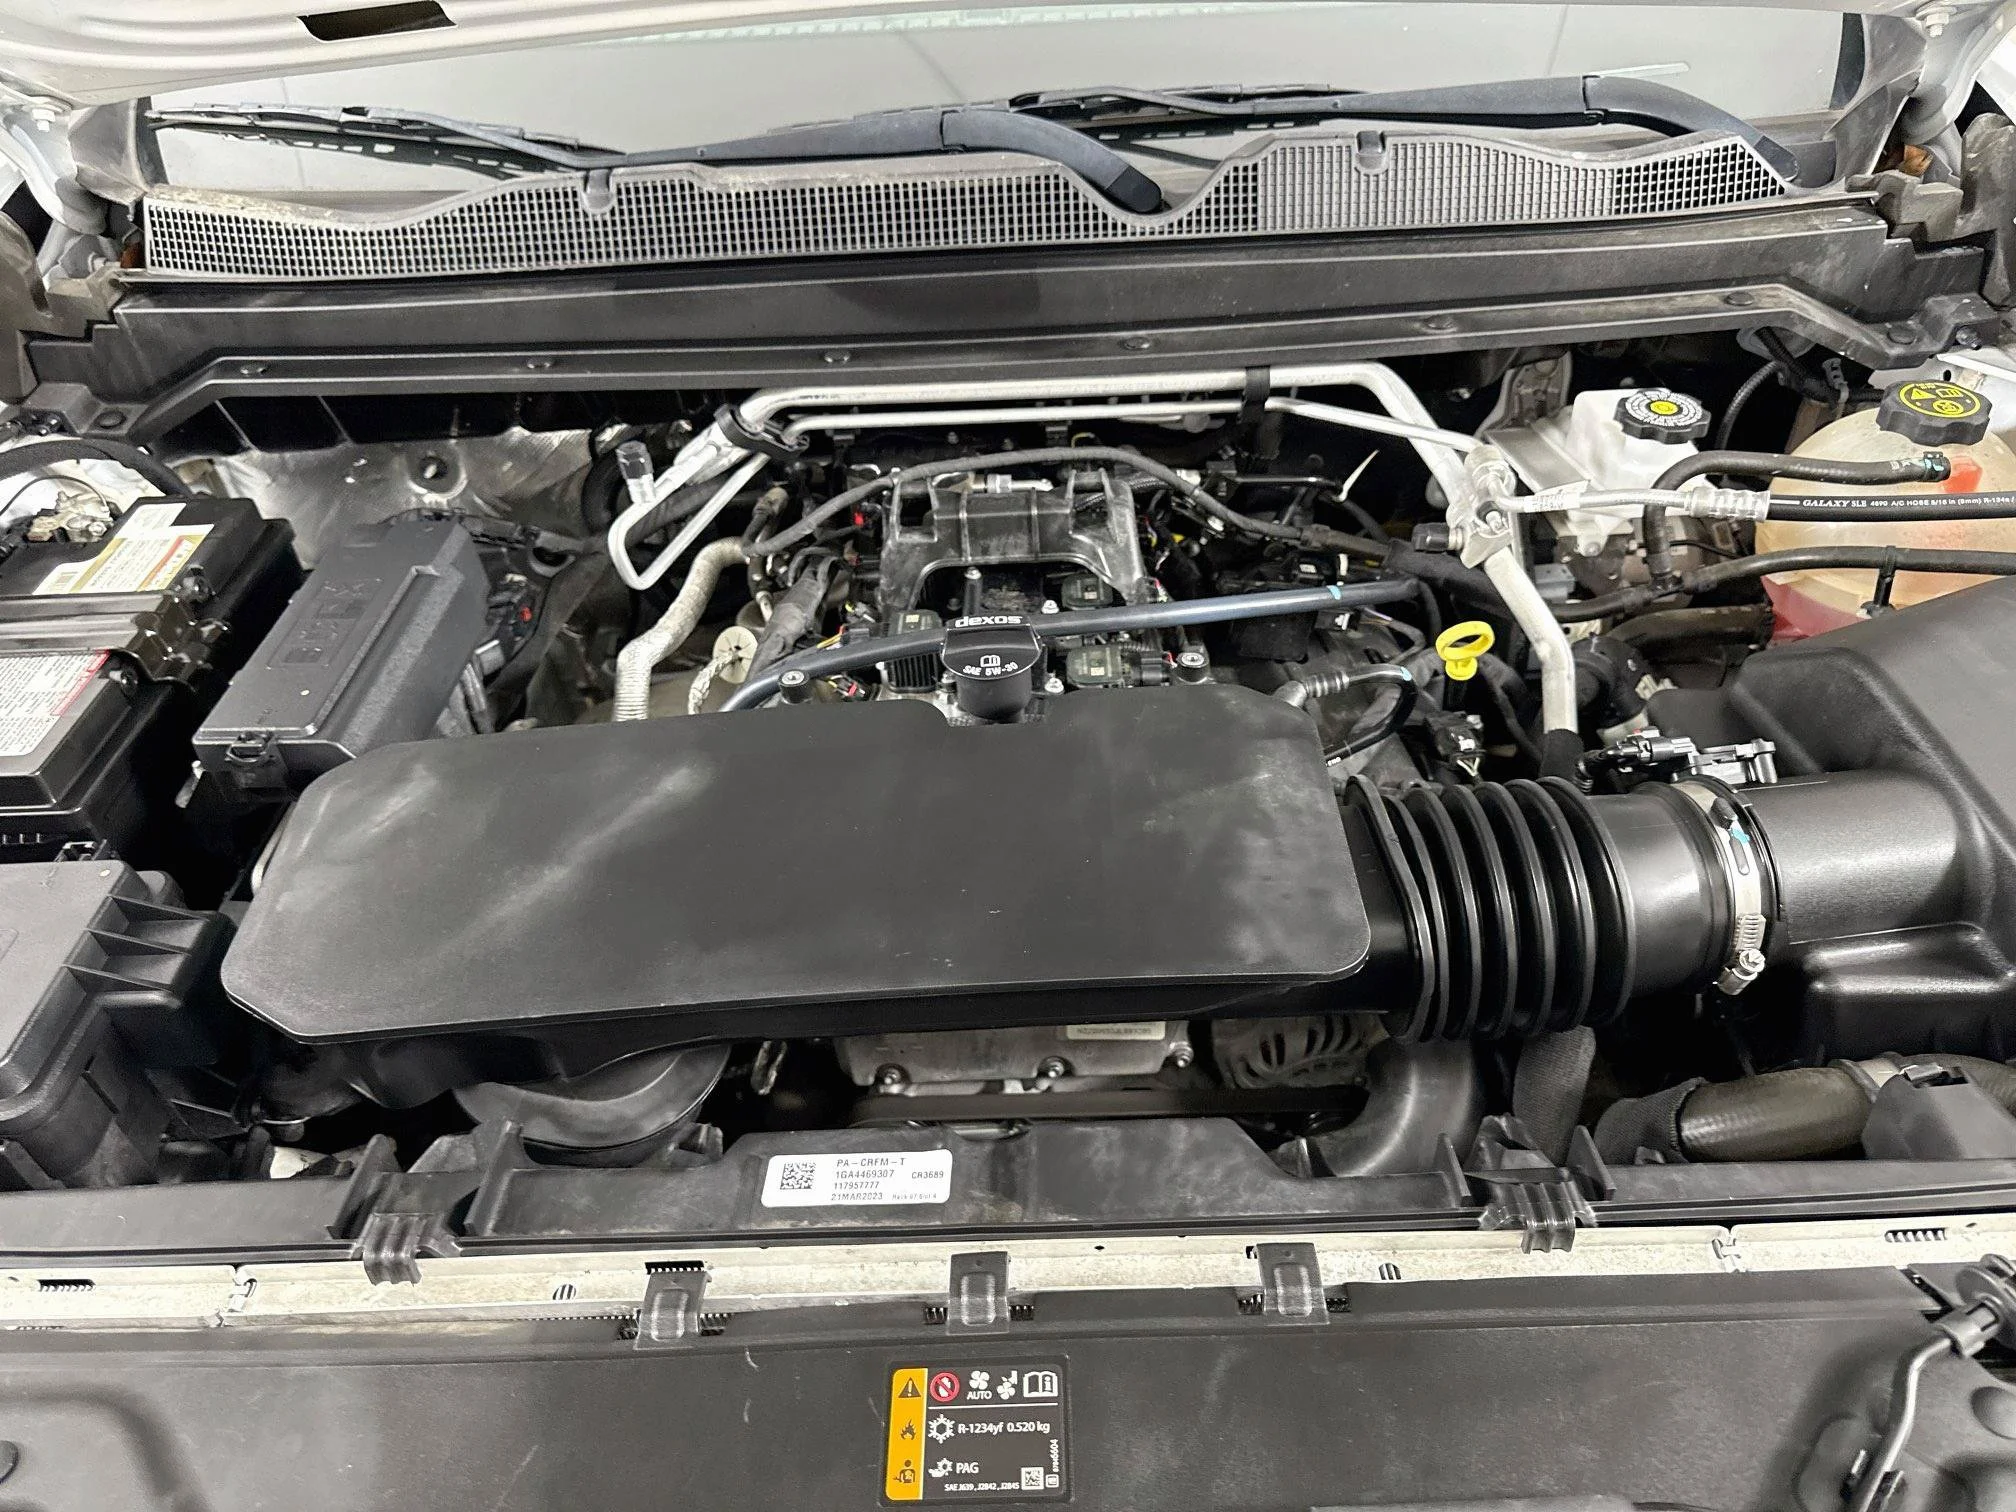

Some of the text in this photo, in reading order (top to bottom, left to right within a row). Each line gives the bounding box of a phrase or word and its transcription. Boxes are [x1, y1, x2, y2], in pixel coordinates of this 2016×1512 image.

[1802, 499, 1850, 508] GALAXY
[1851, 500, 1867, 508] SLE
[954, 615, 1023, 628] dexos
[963, 661, 1019, 676] SAE 5W-30
[835, 1169, 895, 1179] 1GA4469307
[834, 1181, 880, 1190] 117957777
[831, 1191, 884, 1201] 21MAR2023
[966, 1390, 993, 1400] AUTO
[957, 1420, 1051, 1435] R-1234yf 0.520 kg
[955, 1462, 980, 1474] PAG
[944, 1483, 958, 1492] SAE
